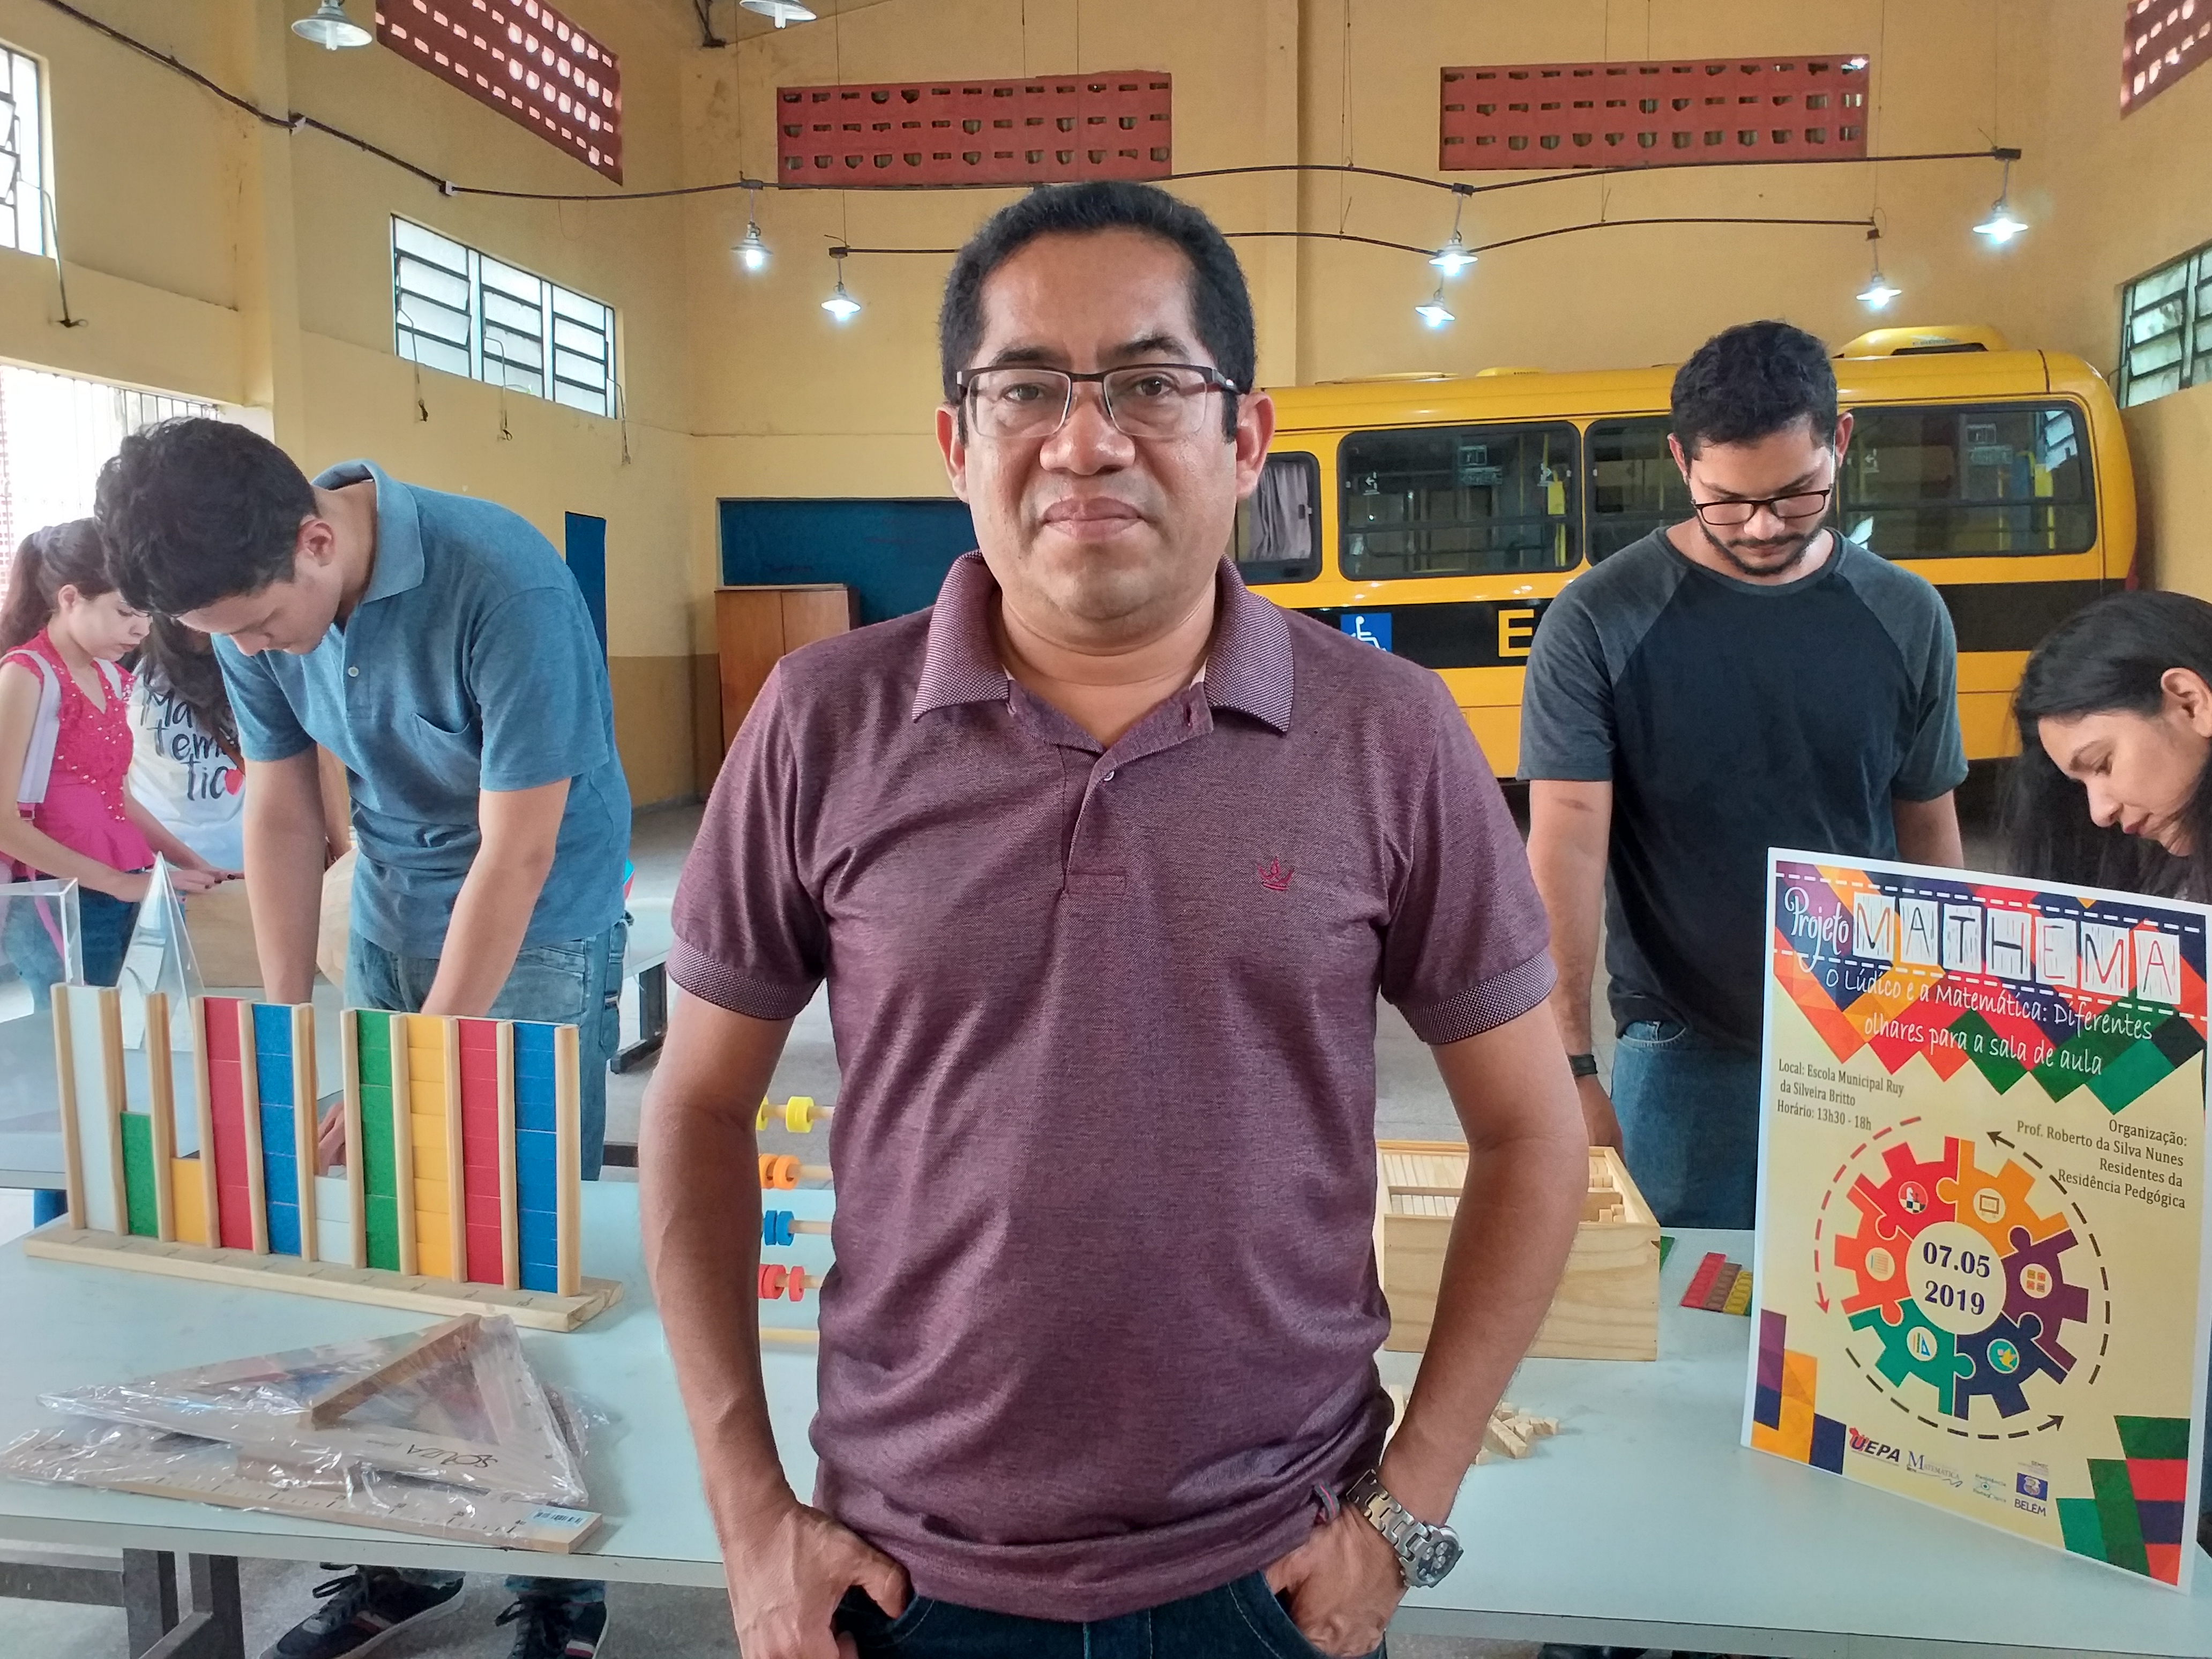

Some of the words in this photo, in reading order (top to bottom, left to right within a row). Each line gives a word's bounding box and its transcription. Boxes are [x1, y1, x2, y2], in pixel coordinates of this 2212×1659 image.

[1784, 886, 1850, 973] Projeto
[1855, 902, 2172, 996] MATHEMA
[1826, 969, 1839, 987] O
[1907, 982, 1914, 1001] e
[1919, 983, 1929, 1002] a
[1865, 1012, 1924, 1043] olhares
[1929, 1028, 1967, 1055] para
[1974, 1035, 1983, 1053] a
[1989, 1035, 2027, 1061] sala
[2034, 1040, 2054, 1067] de
[2060, 1048, 2102, 1075] aula
[1779, 1058, 1804, 1075] Local:
[1807, 1064, 1835, 1081] Escola
[1838, 1070, 1883, 1092] Municipal
[1886, 1079, 1904, 1098] Ruy
[1780, 1079, 1791, 1093] da
[1793, 1082, 1826, 1100] Silveira
[1829, 1089, 1855, 1106] Britto
[1777, 1099, 1814, 1118] Horário:
[1817, 1108, 1845, 1125] 13h30
[1855, 1115, 1872, 1131] 18h
[2109, 1119, 2187, 1146] Organização:
[2017, 1120, 2043, 1137] Prof.
[2047, 1126, 2093, 1147] Roberto
[2096, 1137, 2110, 1151] da
[2113, 1141, 2141, 1158] Silva
[2146, 1147, 2184, 1166] Nunes
[2058, 1169, 2120, 1194] Residência
[2124, 1183, 2185, 1208] Pedgógica
[2100, 1157, 2164, 1183] Residentes
[2168, 1172, 2183, 1187] da
[1923, 1242, 1990, 1277] 07.05
[1925, 1280, 1984, 1315] 2019
[1851, 1436, 1900, 1462] UEPA
